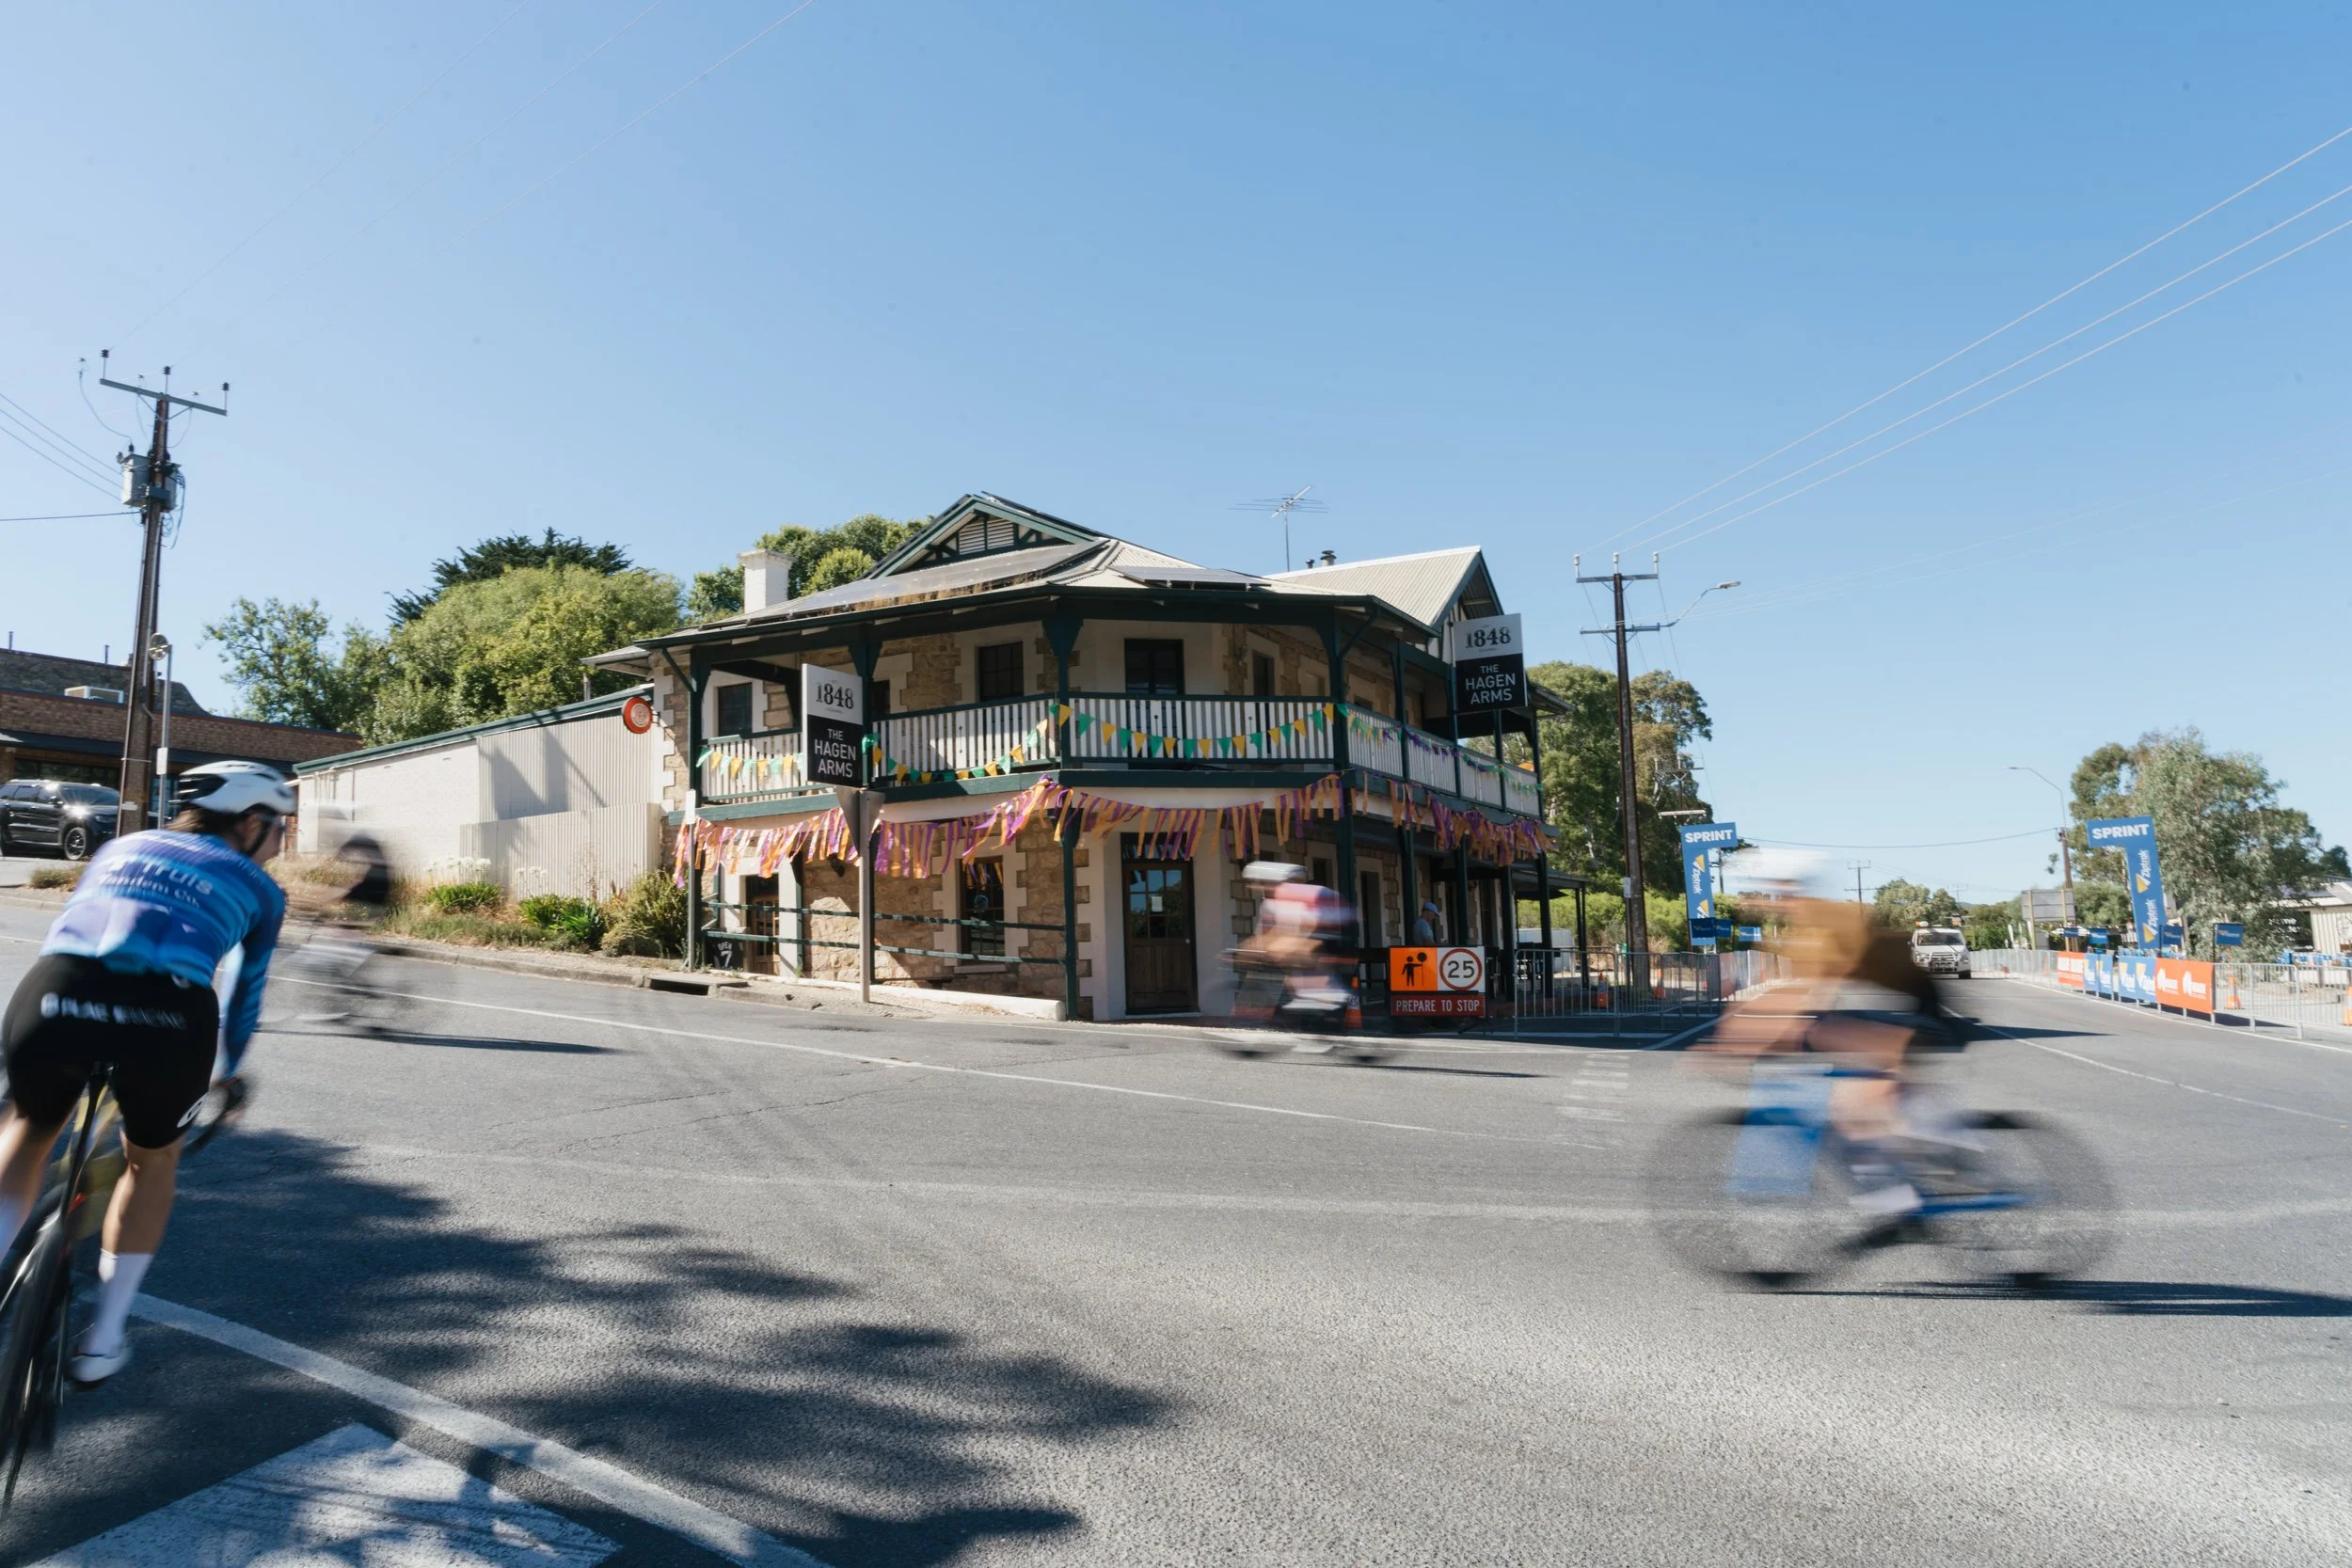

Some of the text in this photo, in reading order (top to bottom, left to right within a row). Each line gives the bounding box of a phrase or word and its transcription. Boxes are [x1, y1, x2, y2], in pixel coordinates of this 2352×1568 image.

[1465, 626, 1512, 649] 1848
[1480, 664, 1499, 673] THE
[1465, 673, 1517, 690] HAGEN
[816, 683, 854, 709] 1848
[1470, 688, 1513, 705] ARMS
[828, 729, 844, 741] THE
[814, 738, 857, 761] HAGEN
[818, 758, 853, 779] ARMS
[1685, 830, 1733, 844] SPRINT
[2092, 824, 2149, 839] SPRINT
[2137, 850, 2151, 878] Ziptrak
[721, 950, 732, 968] 7
[1447, 960, 1475, 979] 25
[1396, 999, 1480, 1012] PREPARE TO STOP
